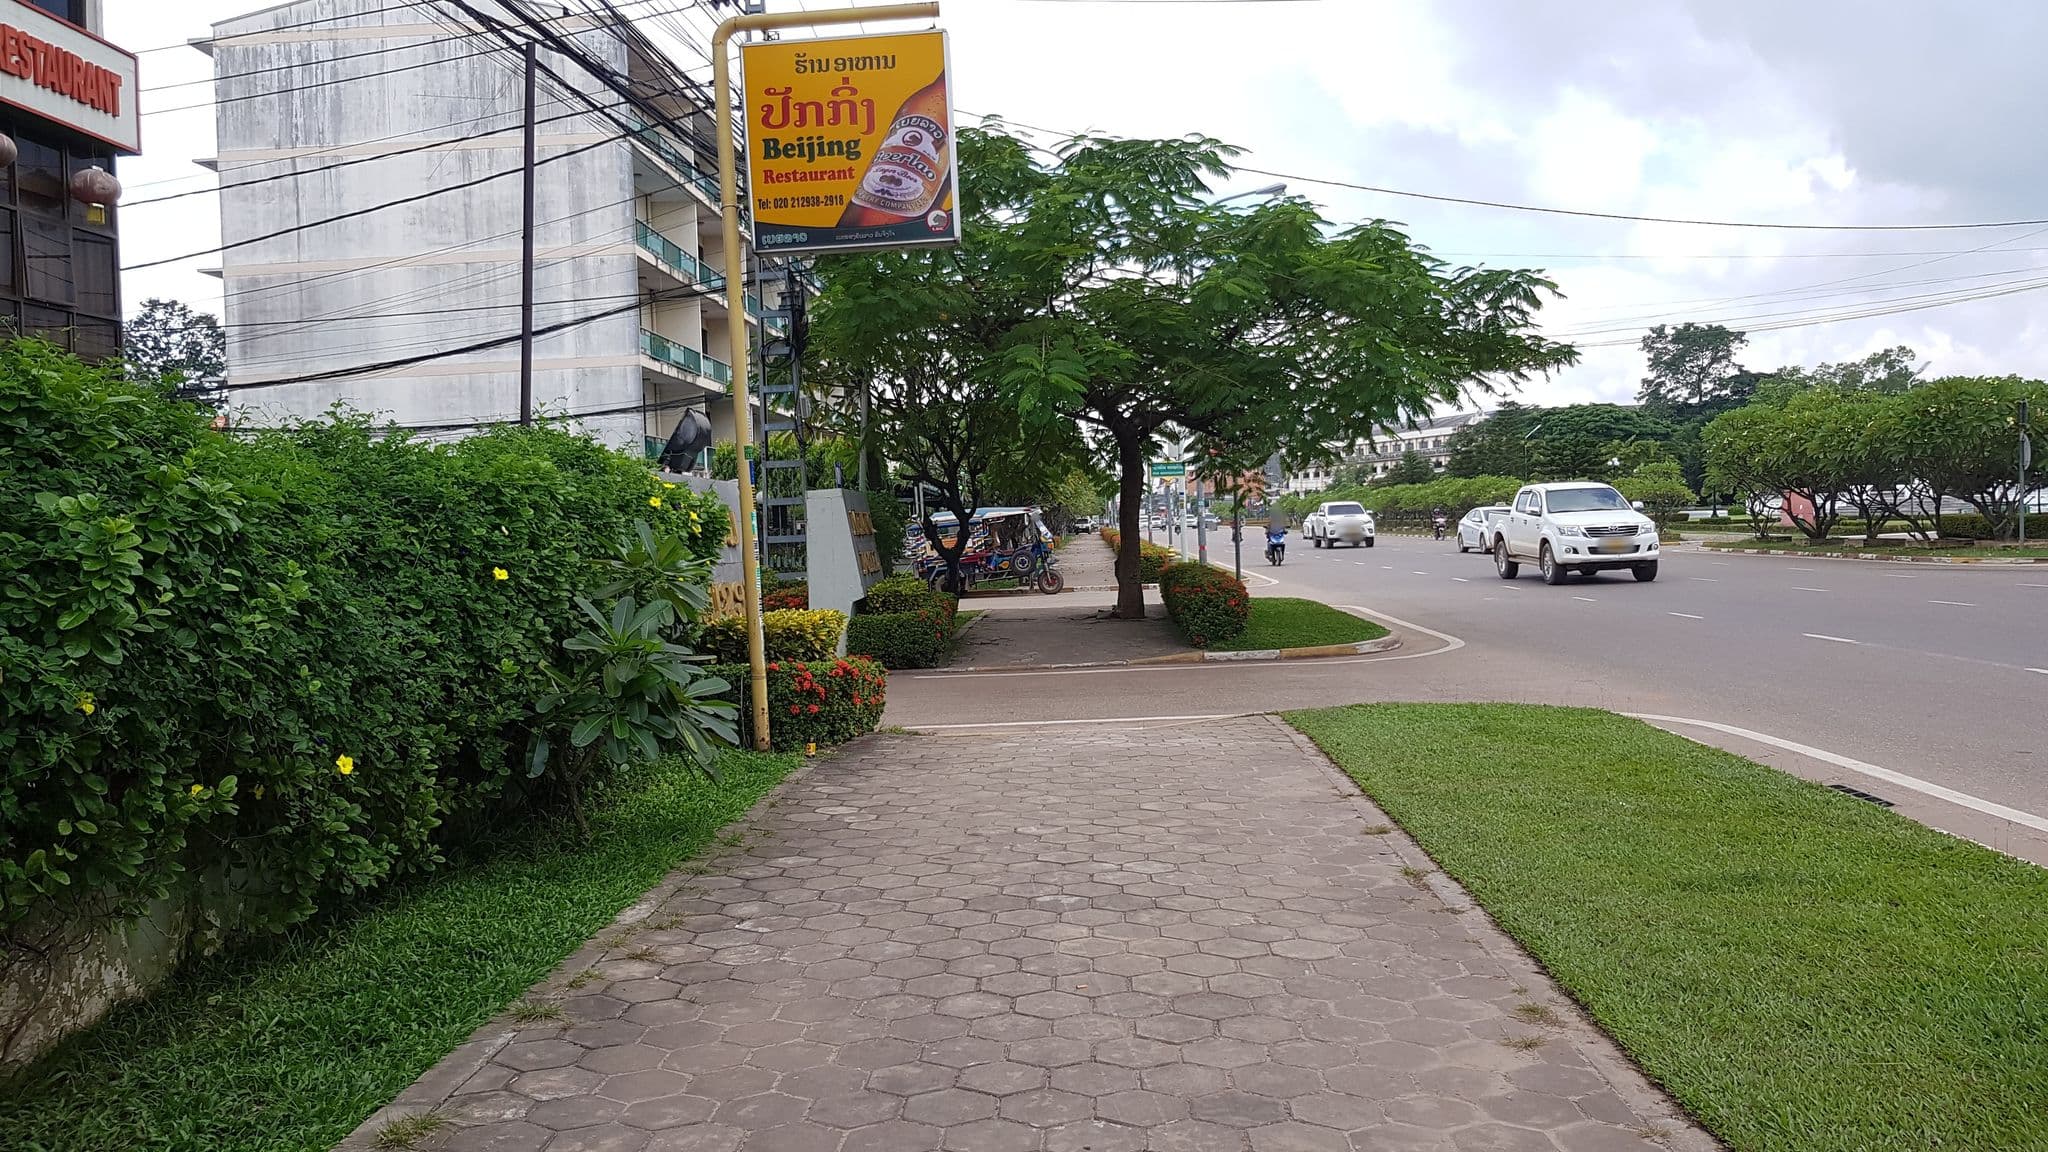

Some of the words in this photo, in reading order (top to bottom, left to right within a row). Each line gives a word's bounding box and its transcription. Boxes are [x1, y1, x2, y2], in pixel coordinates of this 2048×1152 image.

[760, 76, 876, 136] ປັກກິ່ງ
[762, 136, 862, 163] Beijing
[763, 166, 855, 184] Restaurant
[757, 198, 771, 210] Tel:
[773, 197, 788, 209] 020
[791, 195, 844, 208] 212938-2918
